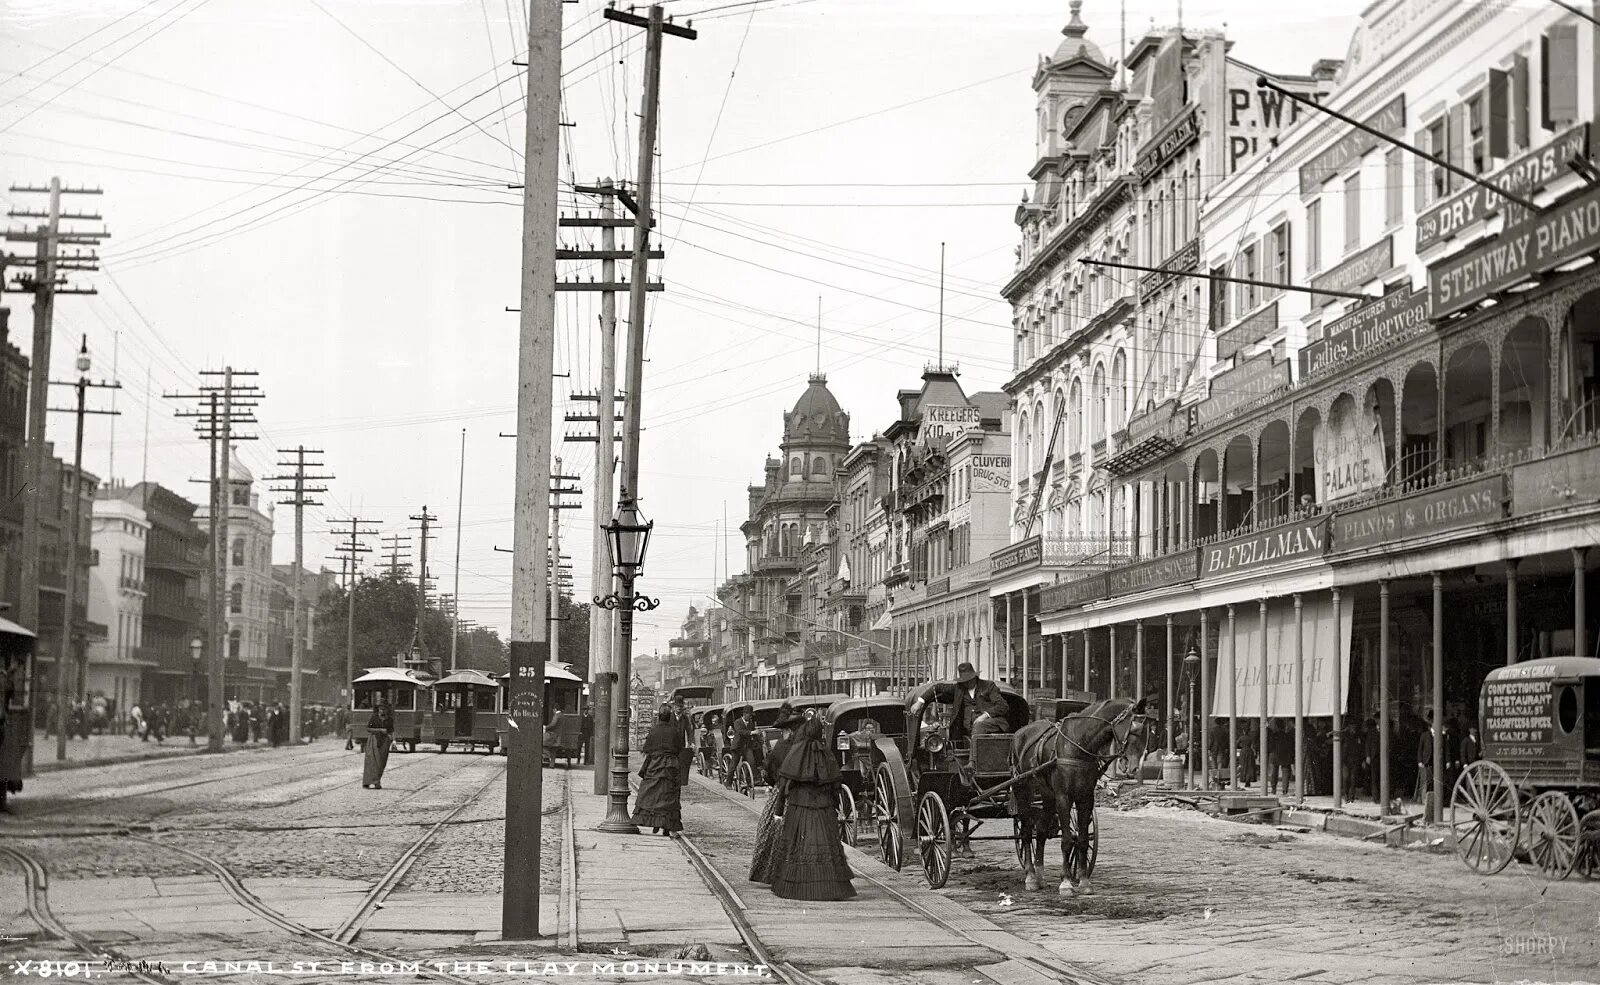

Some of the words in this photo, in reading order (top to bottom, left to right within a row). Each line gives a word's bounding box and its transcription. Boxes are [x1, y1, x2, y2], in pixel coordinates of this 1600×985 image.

[1417, 219, 1438, 243] 129
[1439, 190, 1480, 237] DRY
[1439, 233, 1530, 305] STEINWAY
[1330, 300, 1387, 337] MANUFACTURER
[1306, 338, 1349, 375] Ladies
[973, 467, 995, 481] DRUG
[1344, 512, 1396, 541] PIANOS
[1404, 510, 1416, 527] &
[1424, 488, 1497, 524] ORGANS.
[1208, 549, 1225, 573] B.
[1226, 526, 1322, 570] FELLMAN.
[518, 666, 536, 678] 25
[1487, 681, 1552, 695] CONFECTIONERY
[1493, 694, 1553, 707] RESTAURANT
[1505, 705, 1534, 716] CANAL
